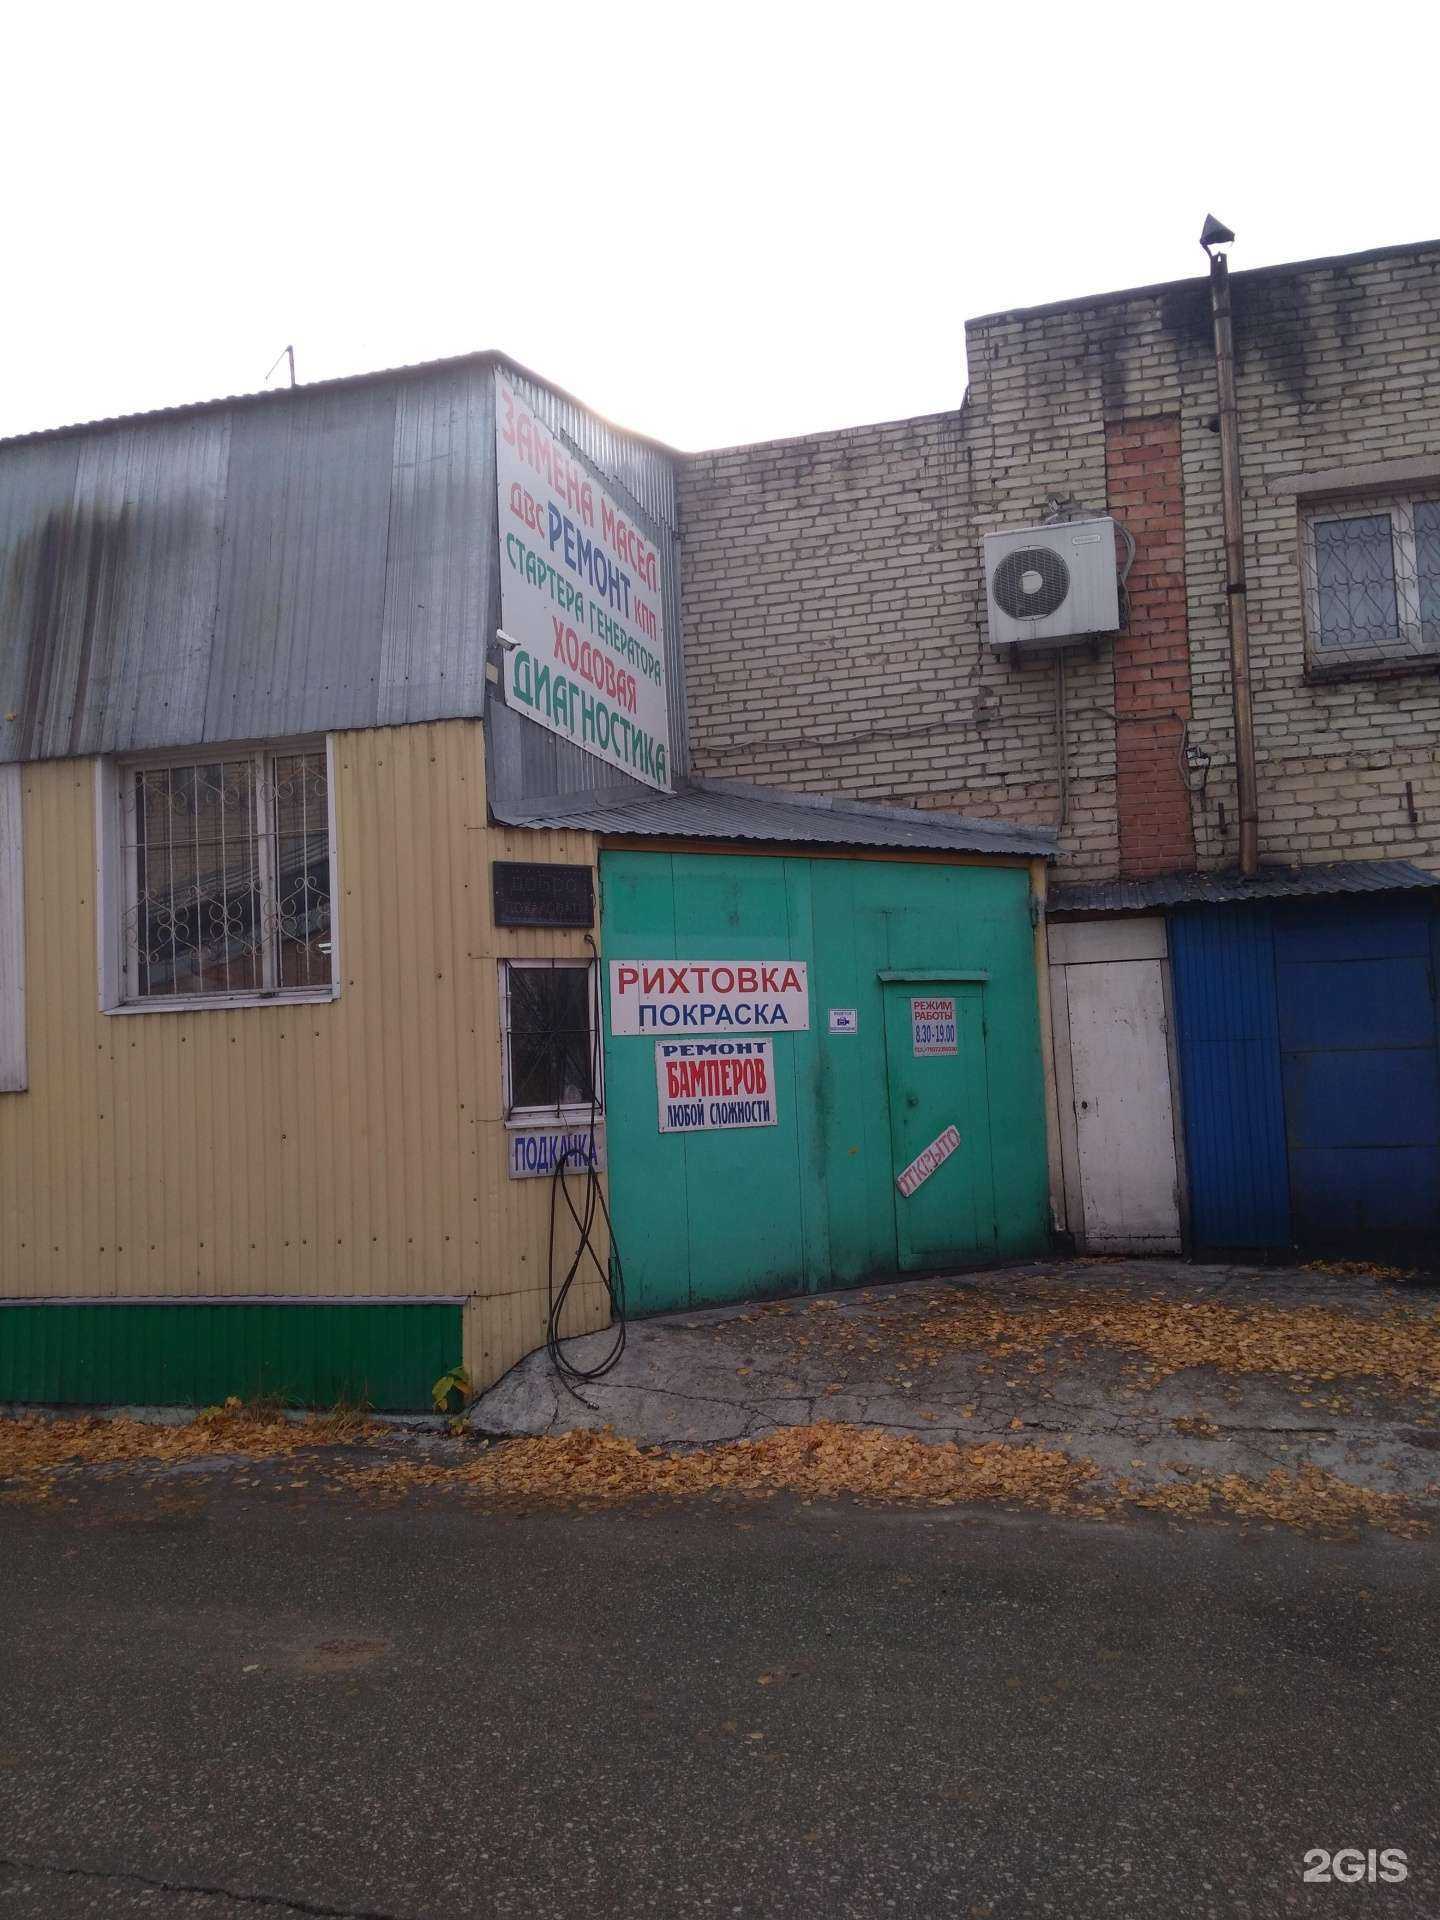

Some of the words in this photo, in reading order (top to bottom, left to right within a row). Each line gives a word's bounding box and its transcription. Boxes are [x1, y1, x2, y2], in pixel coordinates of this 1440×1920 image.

[502, 386, 595, 528] ЗАМЕНА
[601, 497, 658, 593] МАСЕЛ
[510, 482, 545, 539] ДВС
[547, 500, 631, 619] РЕМОНТ
[634, 596, 657, 642] КПП
[506, 532, 584, 624] СТАРТЕРА
[589, 600, 662, 687] ГЕНЕРАТОРА
[552, 615, 637, 715] ХОДОВАЯ
[513, 650, 667, 785] ДИАГНОСТИКА
[618, 967, 803, 995] РИХТОВКА
[639, 1003, 788, 1027] ПОКРАСКА
[914, 1001, 952, 1010] РЕЖИМ
[915, 1011, 953, 1020] РАБОТЫ
[662, 1042, 767, 1057] РЕМОНТ
[666, 1058, 767, 1099] БАМПЕРОВ
[667, 1099, 705, 1127] ЛЮБОЙ
[710, 1100, 770, 1125] СЛОЖНОСТИ
